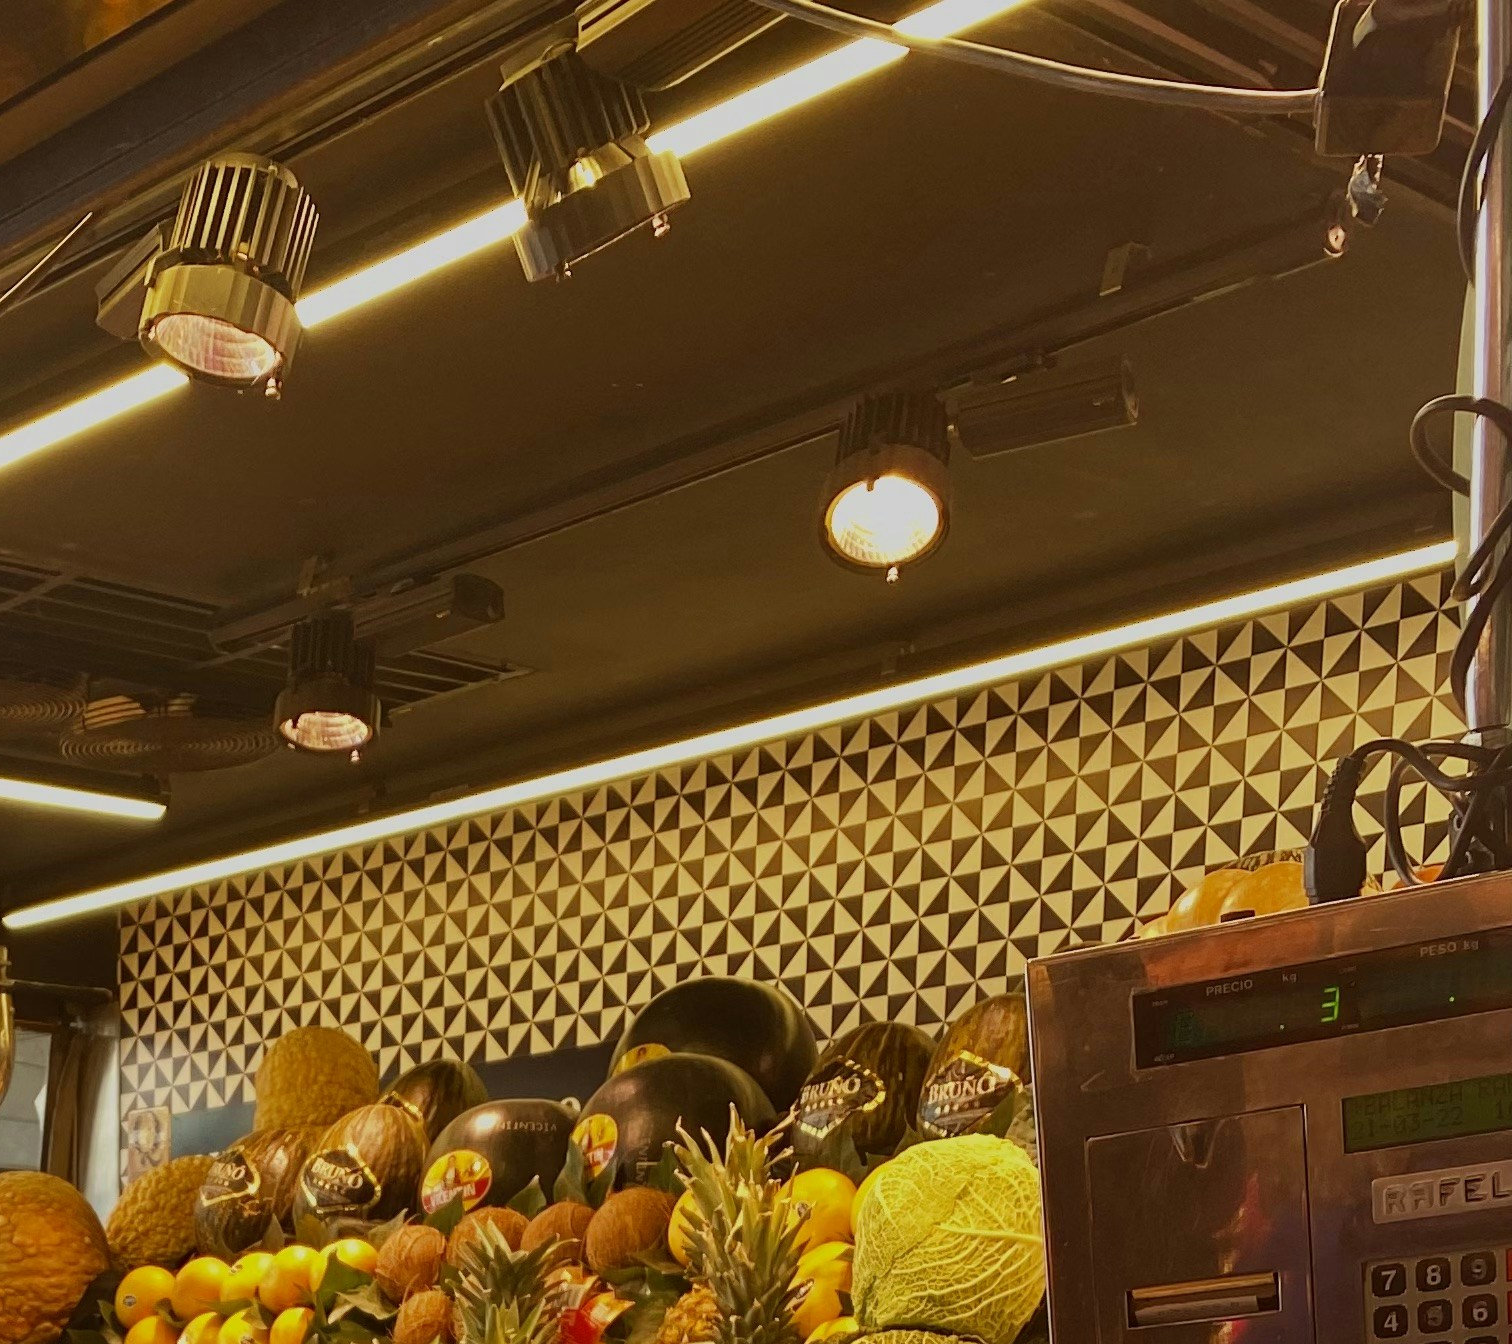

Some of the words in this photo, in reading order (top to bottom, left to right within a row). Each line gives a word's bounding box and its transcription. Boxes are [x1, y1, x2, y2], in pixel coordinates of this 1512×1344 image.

[1420, 942, 1457, 958] PESO
[1206, 979, 1253, 996] PRECIO
[1381, 1269, 1397, 1291] 7
[1426, 1264, 1441, 1286] 8
[1384, 1311, 1399, 1332] 4
[1472, 1301, 1489, 1323] 6
